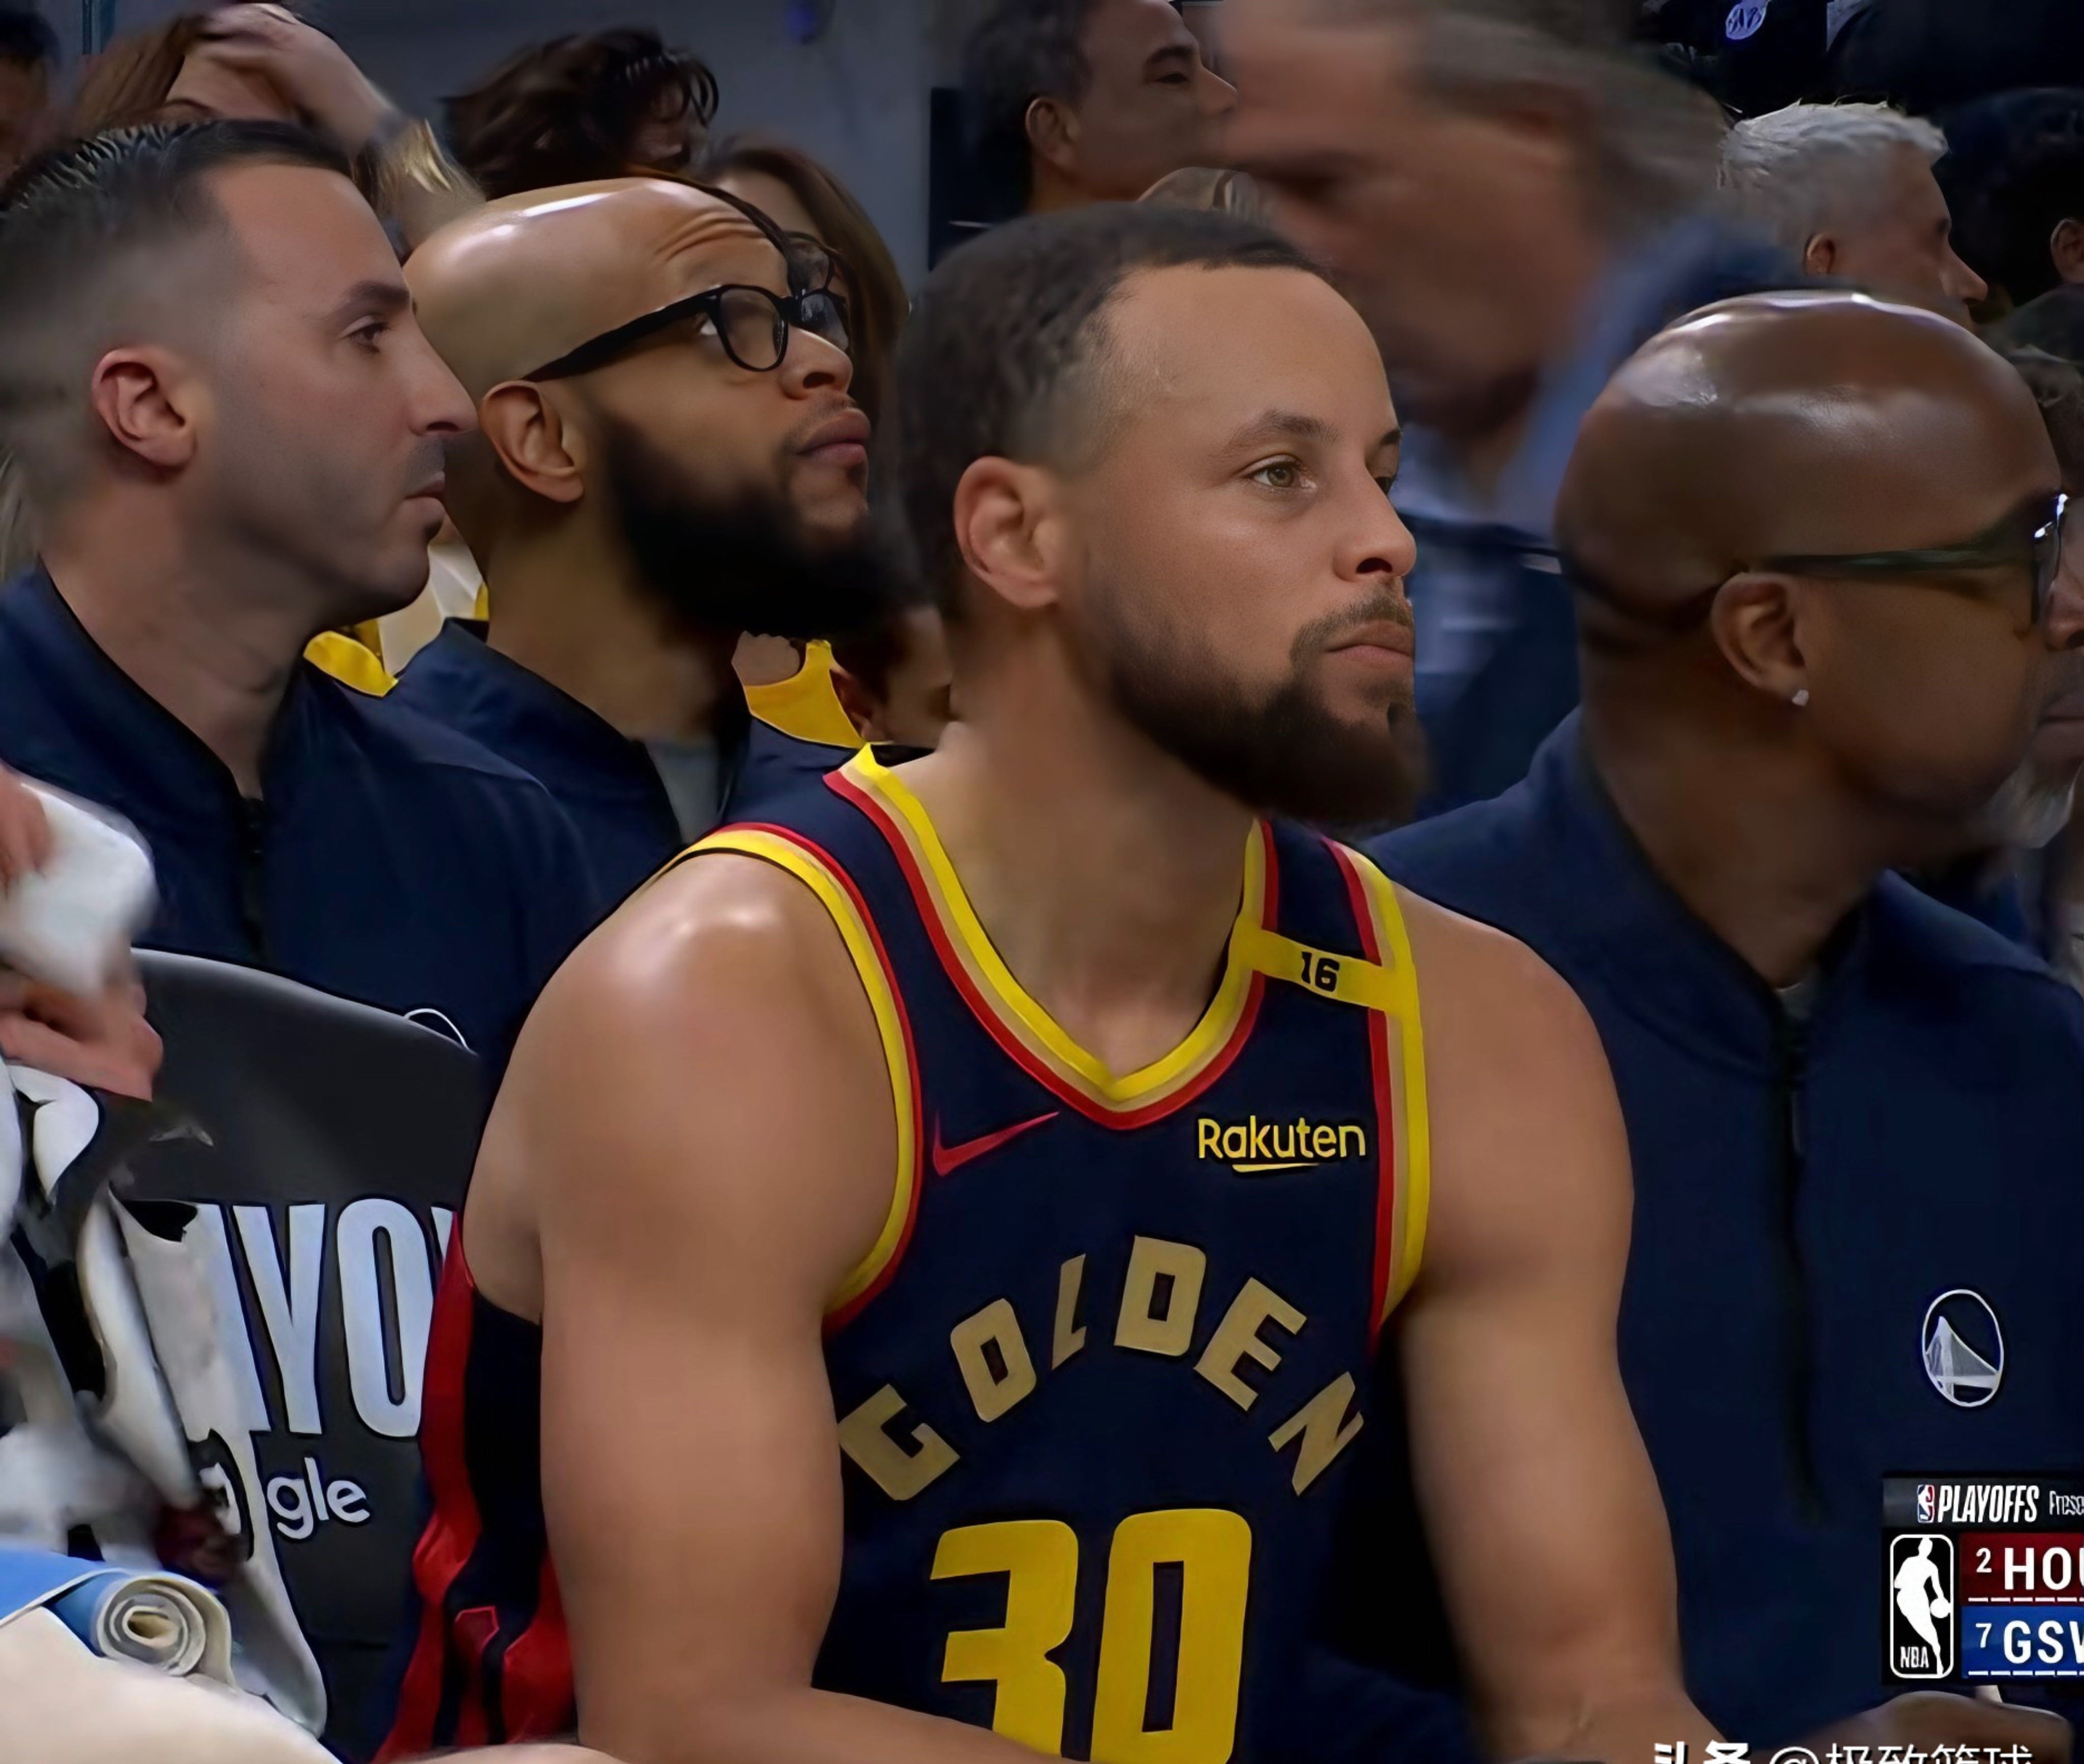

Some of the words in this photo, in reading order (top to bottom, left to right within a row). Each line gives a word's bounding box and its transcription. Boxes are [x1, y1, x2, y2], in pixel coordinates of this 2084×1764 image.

[1301, 951, 1340, 992] 16
[1198, 1115, 1367, 1159] Rakuten
[837, 1234, 1365, 1500] GOLDEN
[930, 1508, 1252, 1764] 30
